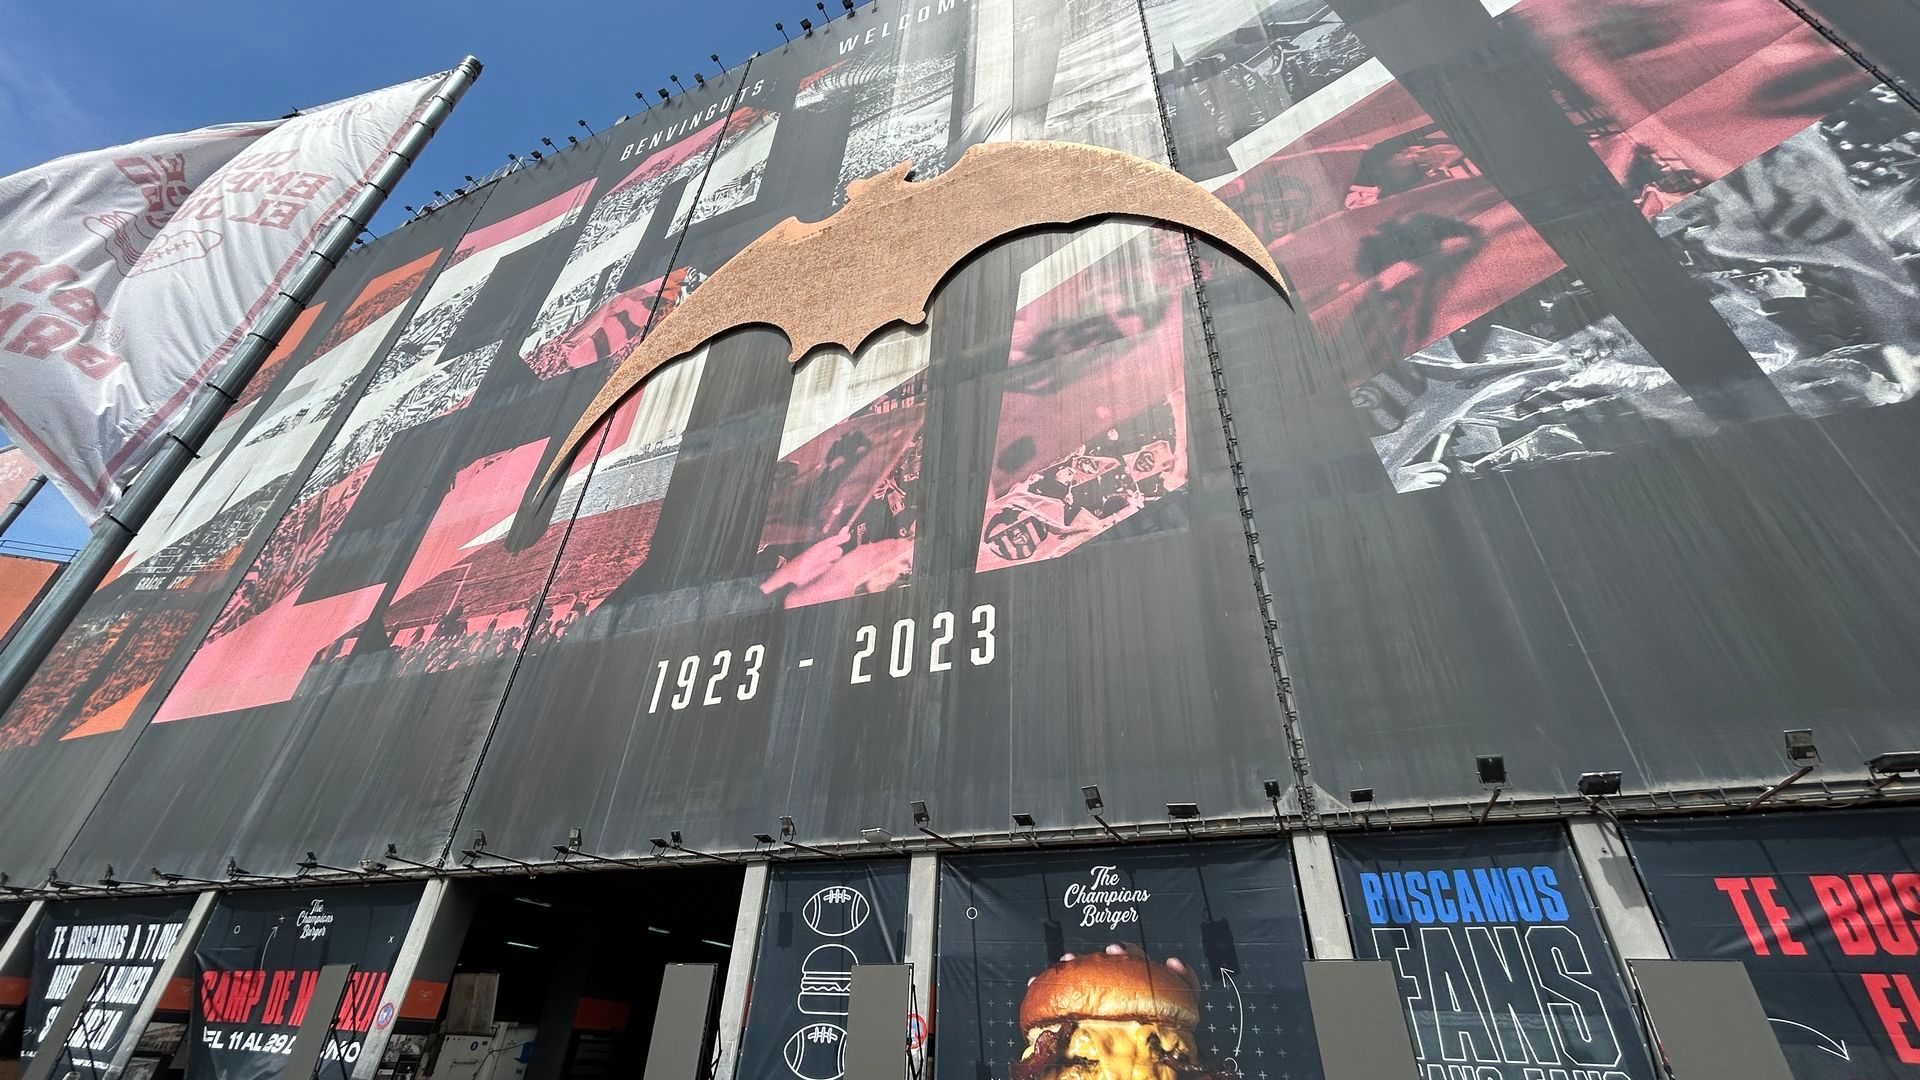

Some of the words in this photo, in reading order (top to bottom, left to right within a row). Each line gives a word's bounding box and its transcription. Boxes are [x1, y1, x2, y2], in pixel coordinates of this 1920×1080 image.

[839, 0, 969, 55] WELCOM
[619, 79, 765, 162] BENVINGUTS
[648, 643, 766, 714] 1923
[799, 657, 815, 668] -
[849, 603, 996, 685] 2023
[1090, 865, 1120, 890] The
[1360, 866, 1570, 924] BUSCAMOS
[310, 898, 324, 915] The
[1064, 883, 1151, 909] Champions
[296, 910, 334, 927] Champions
[300, 923, 326, 941] Burger
[1079, 904, 1139, 931] Burger
[1713, 877, 1808, 956] TE
[48, 926, 69, 960] TE
[65, 924, 131, 960] BUSCAMOS
[126, 924, 142, 960] A
[104, 966, 154, 1005] BURGER
[202, 970, 266, 1024] CAMP
[261, 970, 296, 1025] DE
[240, 1032, 264, 1052] AL
[261, 1033, 289, 1054] 29
